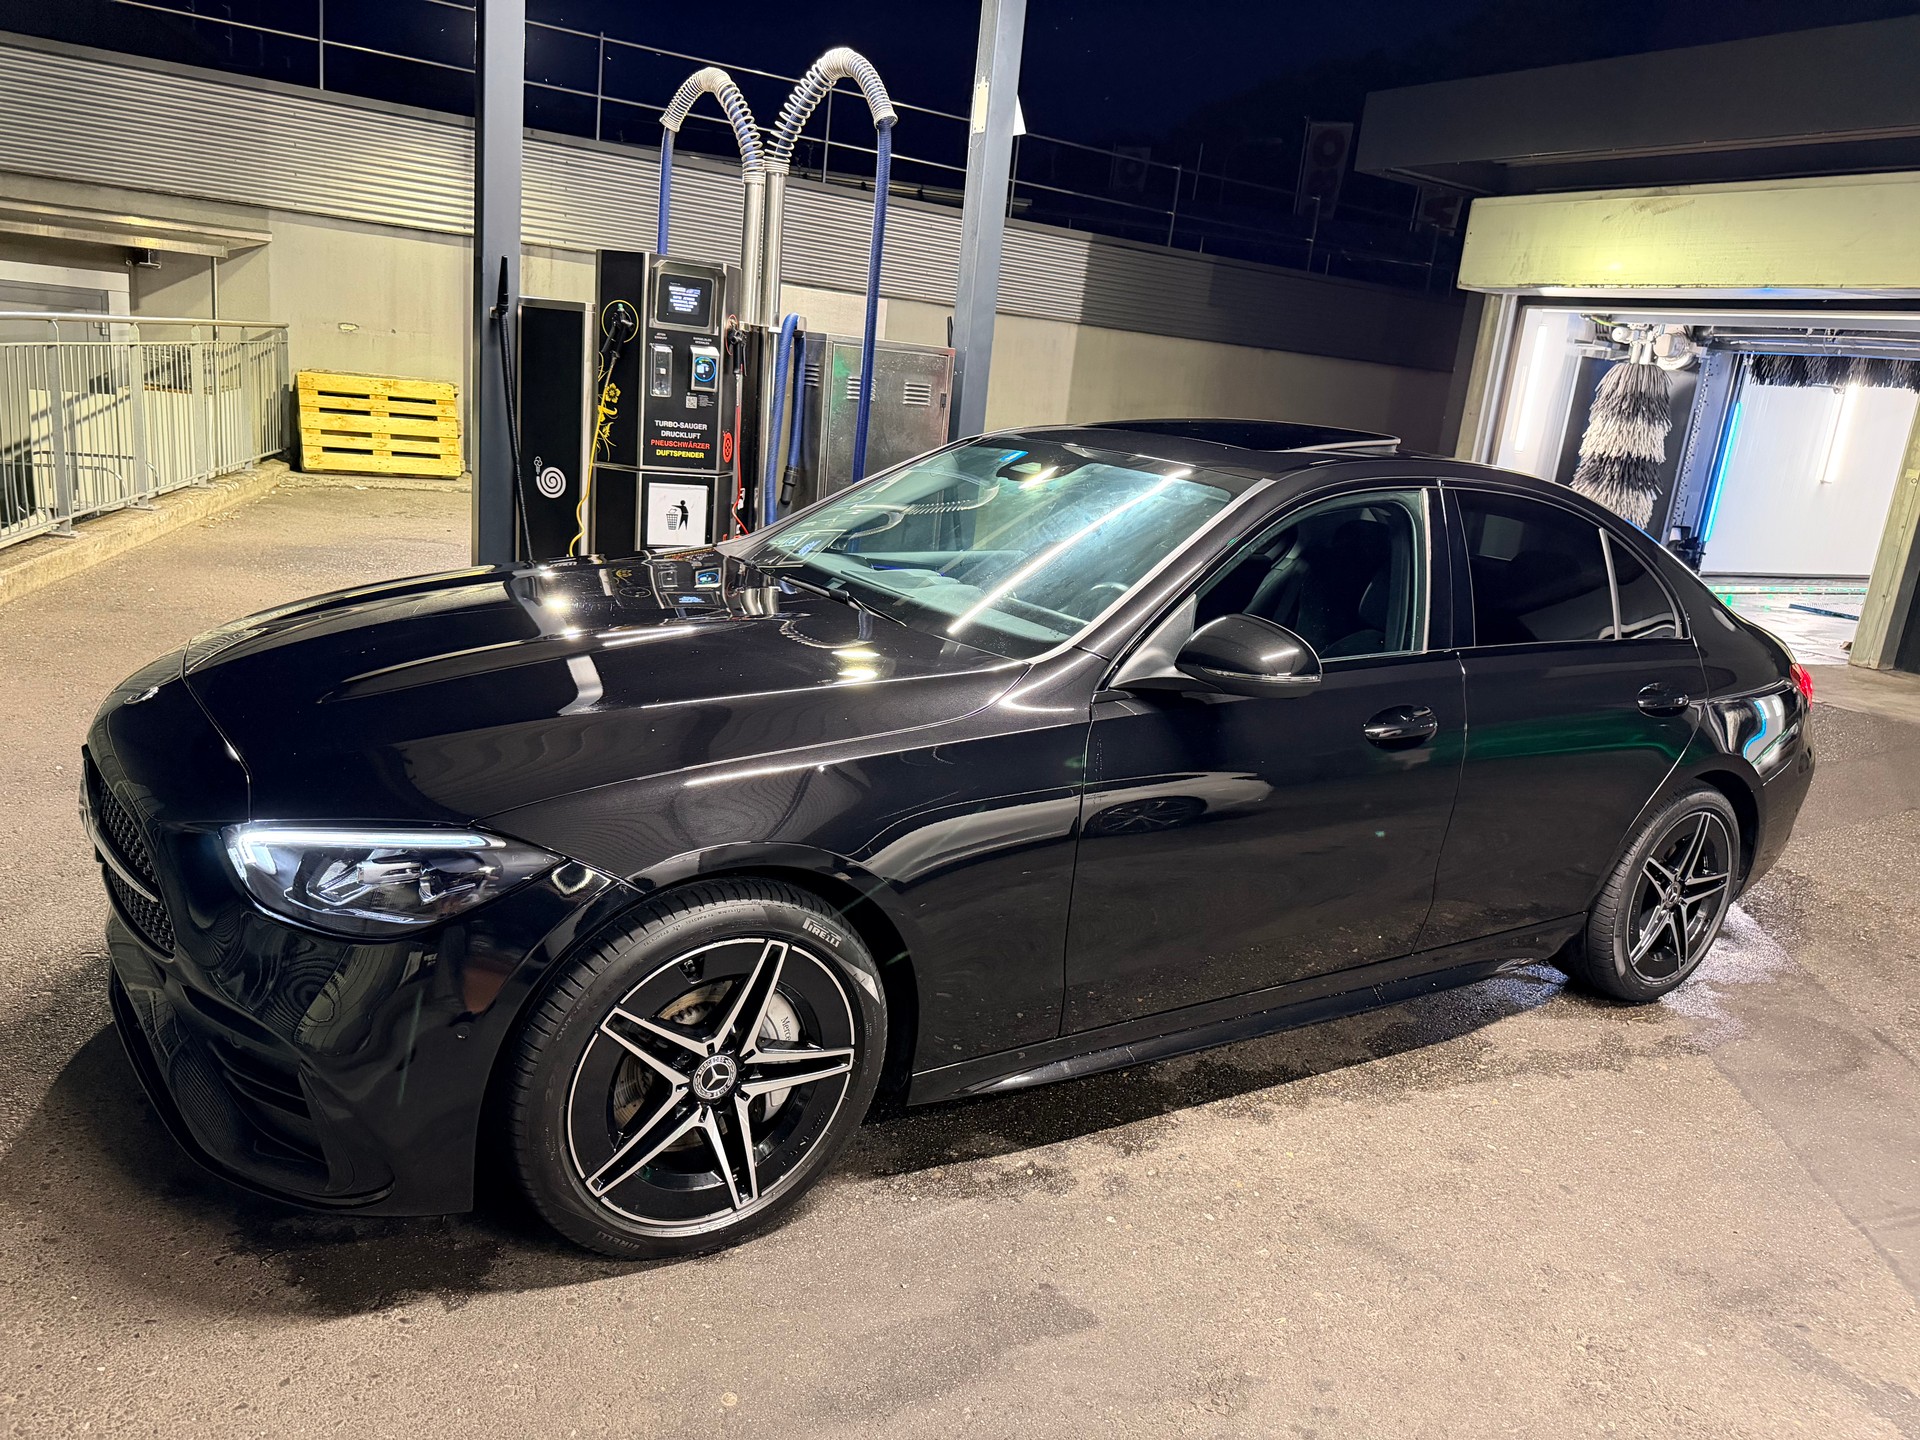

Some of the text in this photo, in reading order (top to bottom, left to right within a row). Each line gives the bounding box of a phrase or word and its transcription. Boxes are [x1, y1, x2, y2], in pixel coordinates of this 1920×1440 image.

[654, 420, 708, 431] TURBO-SAUGER
[660, 430, 701, 440] DRUCKLUFT
[650, 439, 711, 450] PNEUSCHWÄRZER
[655, 449, 705, 459] DUFTSPENDER
[802, 917, 842, 948] PIRELLI
